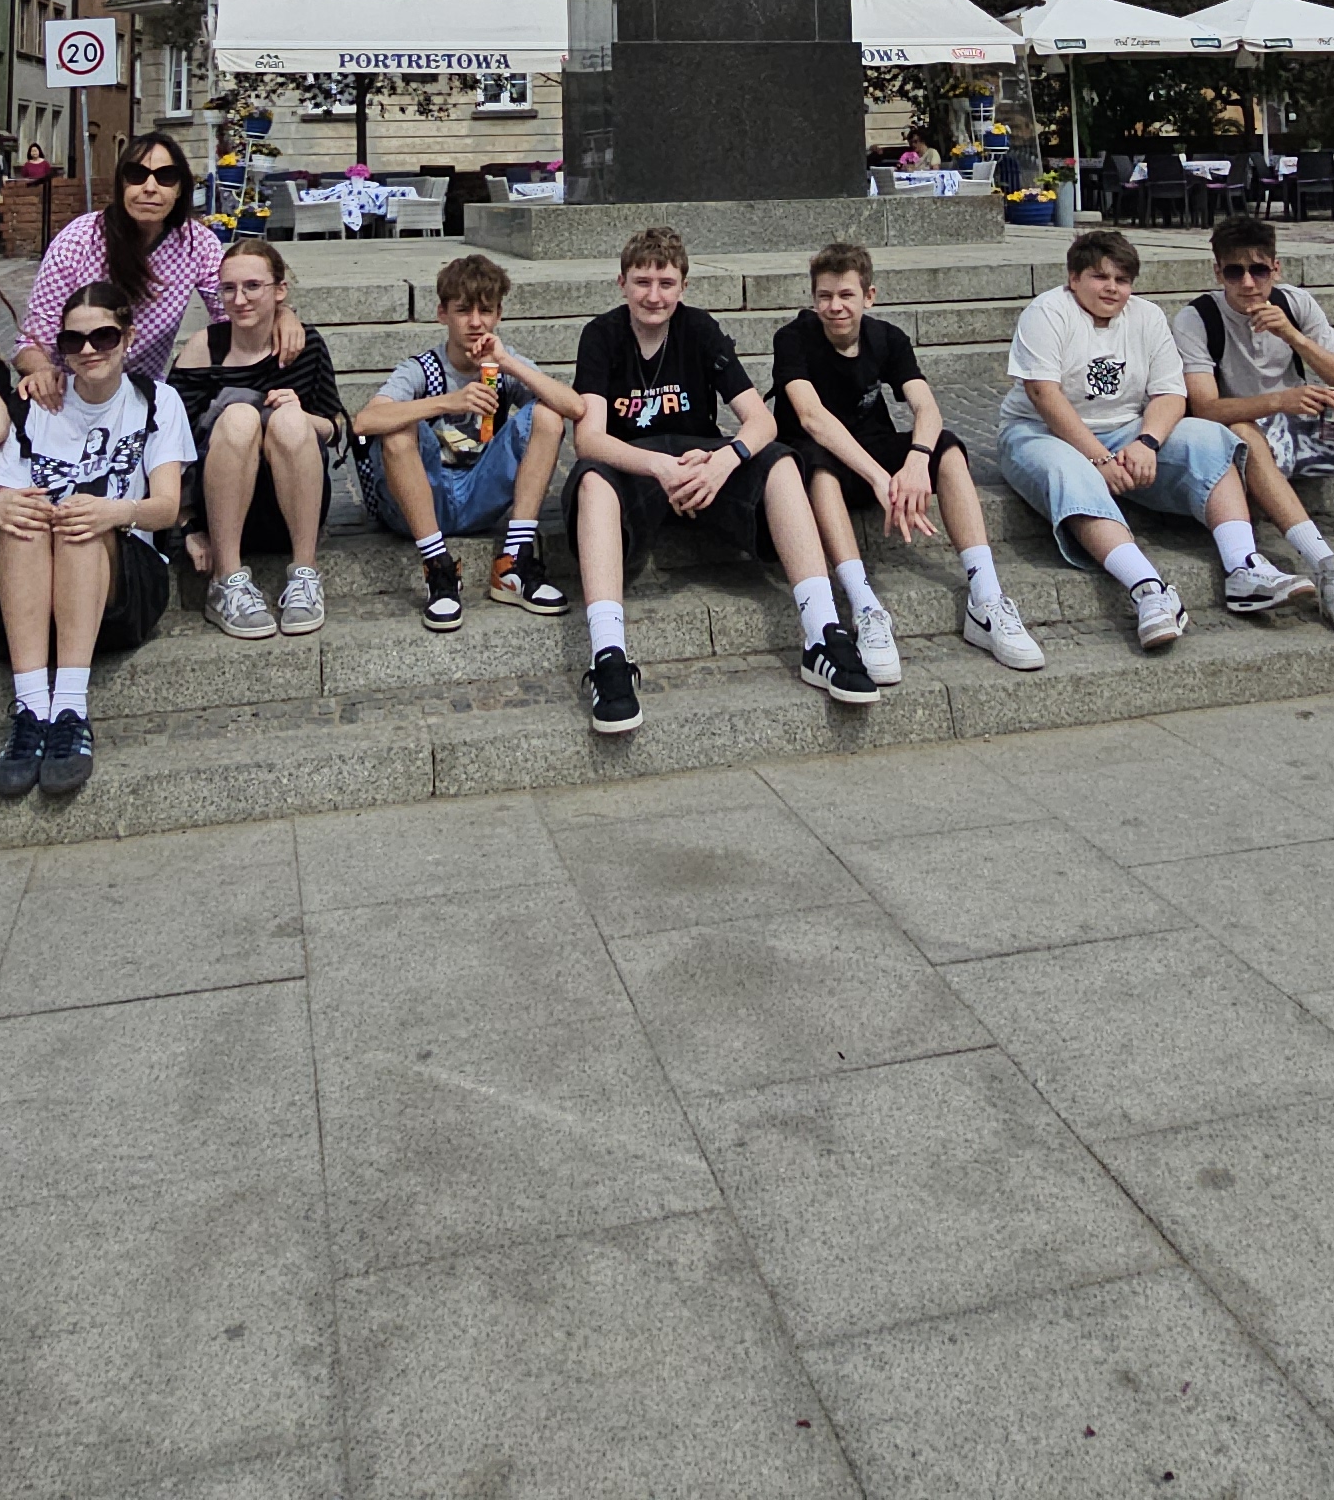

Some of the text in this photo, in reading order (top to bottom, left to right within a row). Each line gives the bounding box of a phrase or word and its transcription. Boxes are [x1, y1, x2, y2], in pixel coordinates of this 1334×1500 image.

[67, 43, 98, 63] 20
[338, 53, 512, 70] PORTRETOWA
[255, 58, 285, 69] evian
